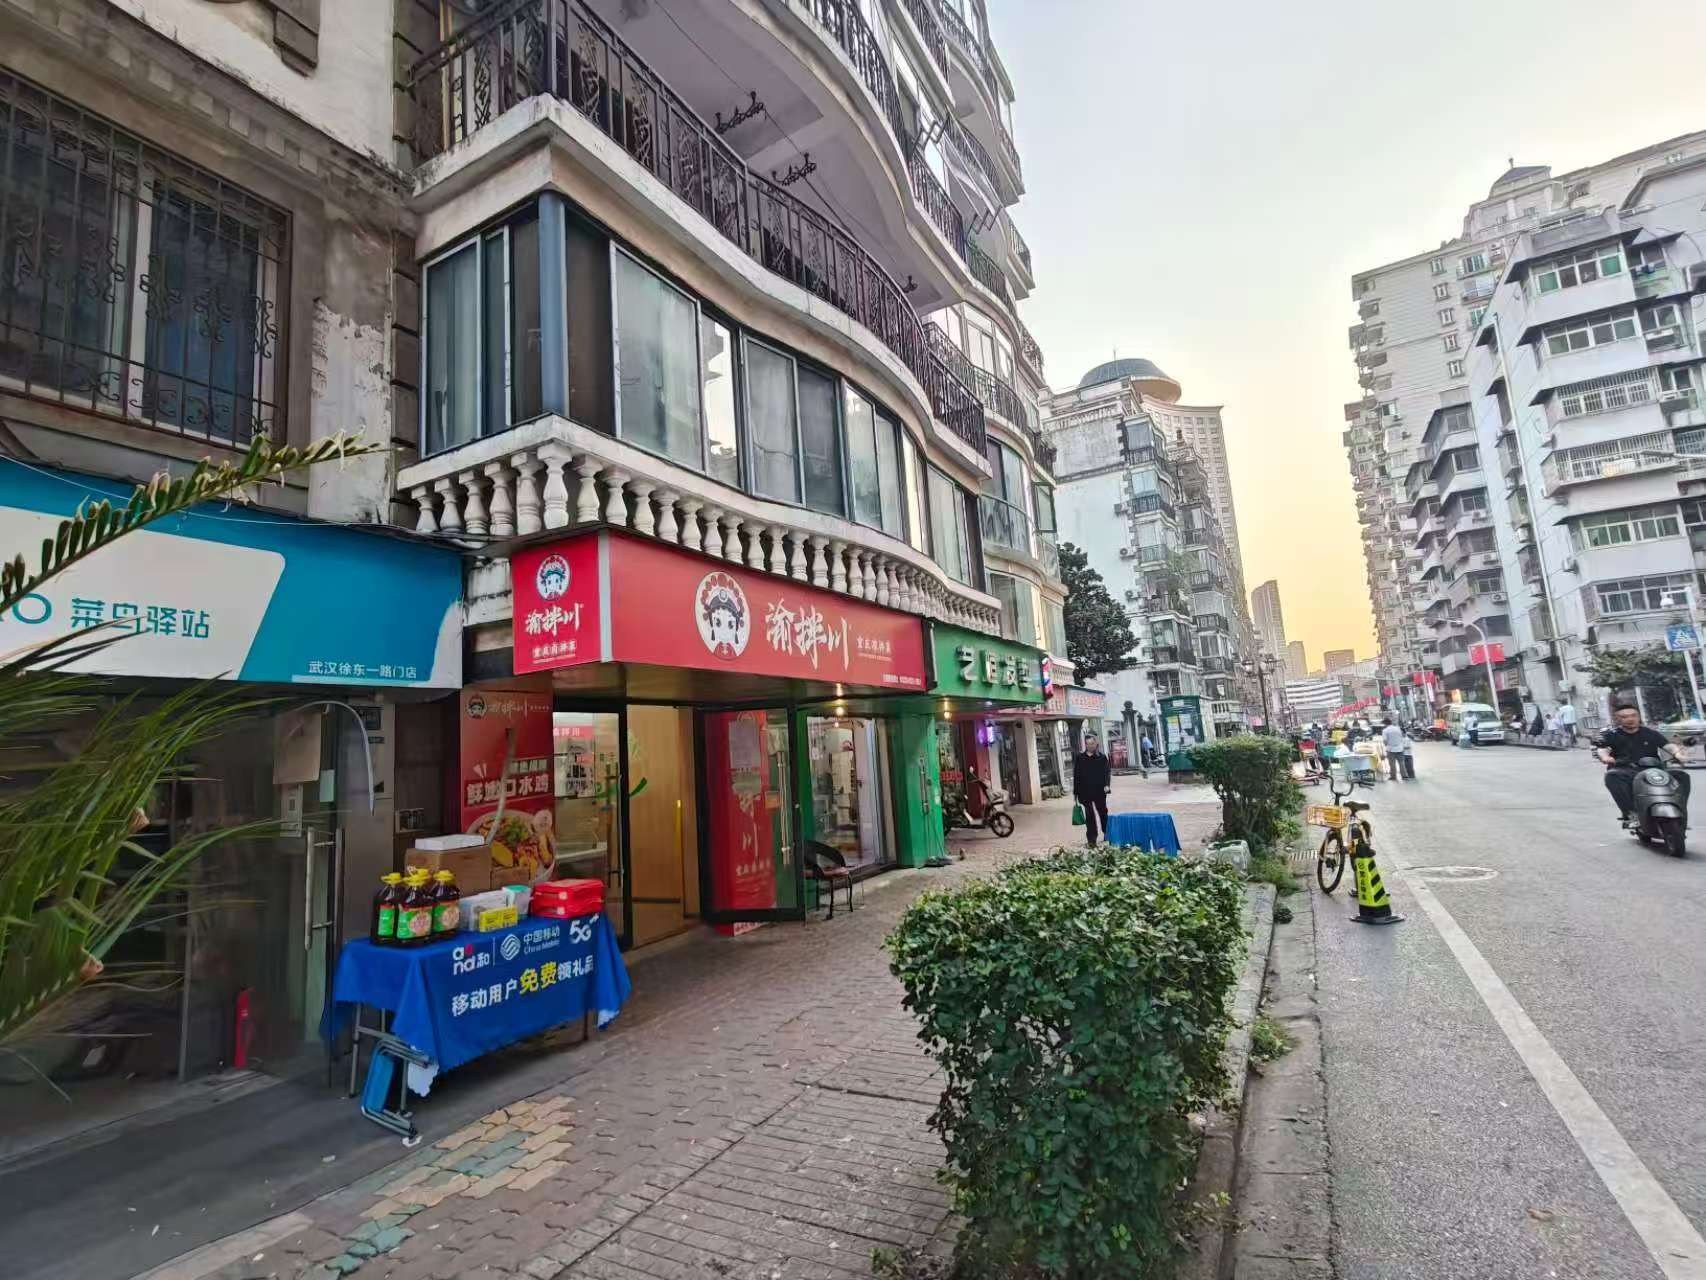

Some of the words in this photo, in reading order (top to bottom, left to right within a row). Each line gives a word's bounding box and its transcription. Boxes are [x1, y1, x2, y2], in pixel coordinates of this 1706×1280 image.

[71, 597, 210, 638] 菜鸟驿站
[525, 602, 580, 636] 渝拌川
[765, 598, 850, 672] 渝拌川
[308, 660, 417, 679] 武汉徐东一路门店
[523, 926, 560, 945] 中国移动
[477, 952, 490, 969] 和
[524, 944, 541, 955] China
[451, 954, 594, 1017] 移动用户免费领礼品
